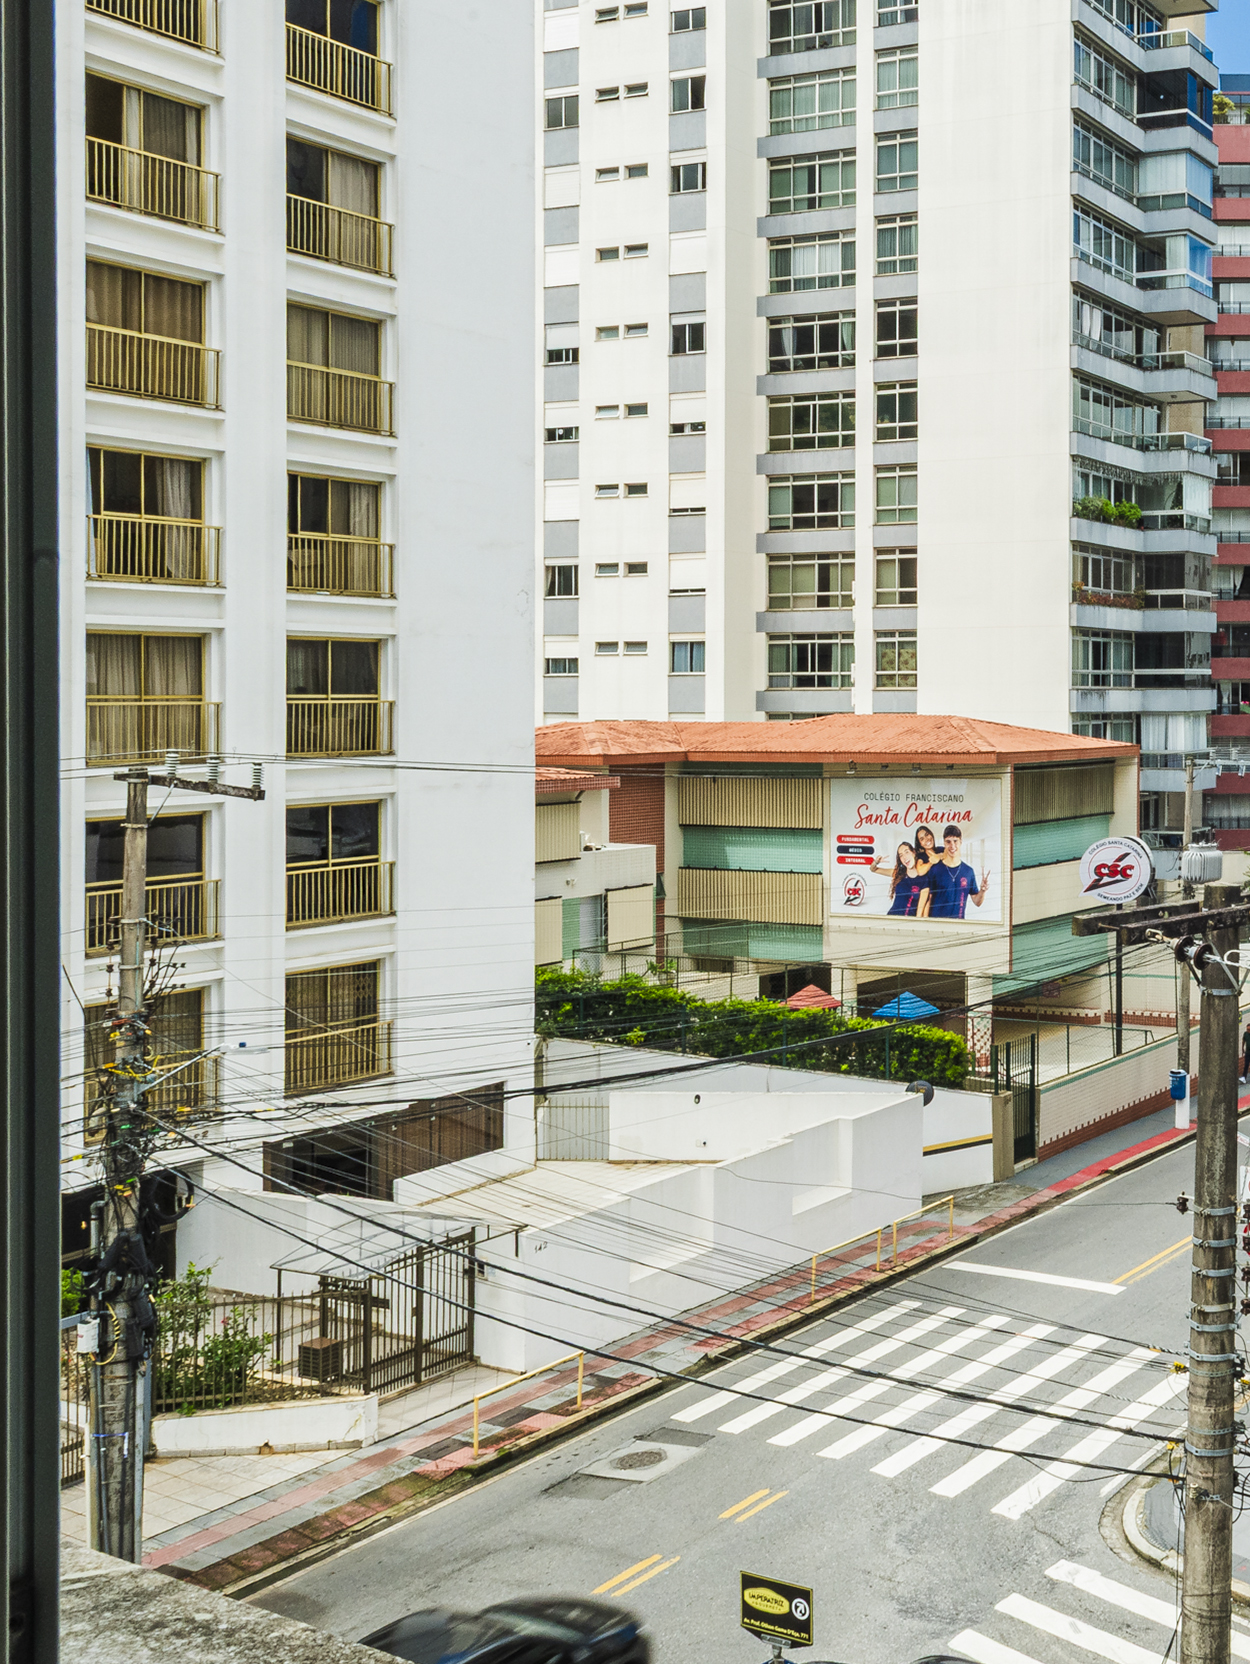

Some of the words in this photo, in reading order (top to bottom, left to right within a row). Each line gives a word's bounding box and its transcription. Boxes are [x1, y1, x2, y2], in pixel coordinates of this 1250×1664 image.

[864, 791, 900, 801] COLÉGIO
[905, 793, 964, 803] FRANCISCANO
[854, 803, 902, 829] Santa
[903, 802, 973, 827] Catarina
[1088, 841, 1107, 855] COLÉGIO
[1123, 842, 1143, 859] CATARINA
[1097, 892, 1123, 902] SEMEANDO
[748, 1591, 785, 1608] IMPERATRIZ
